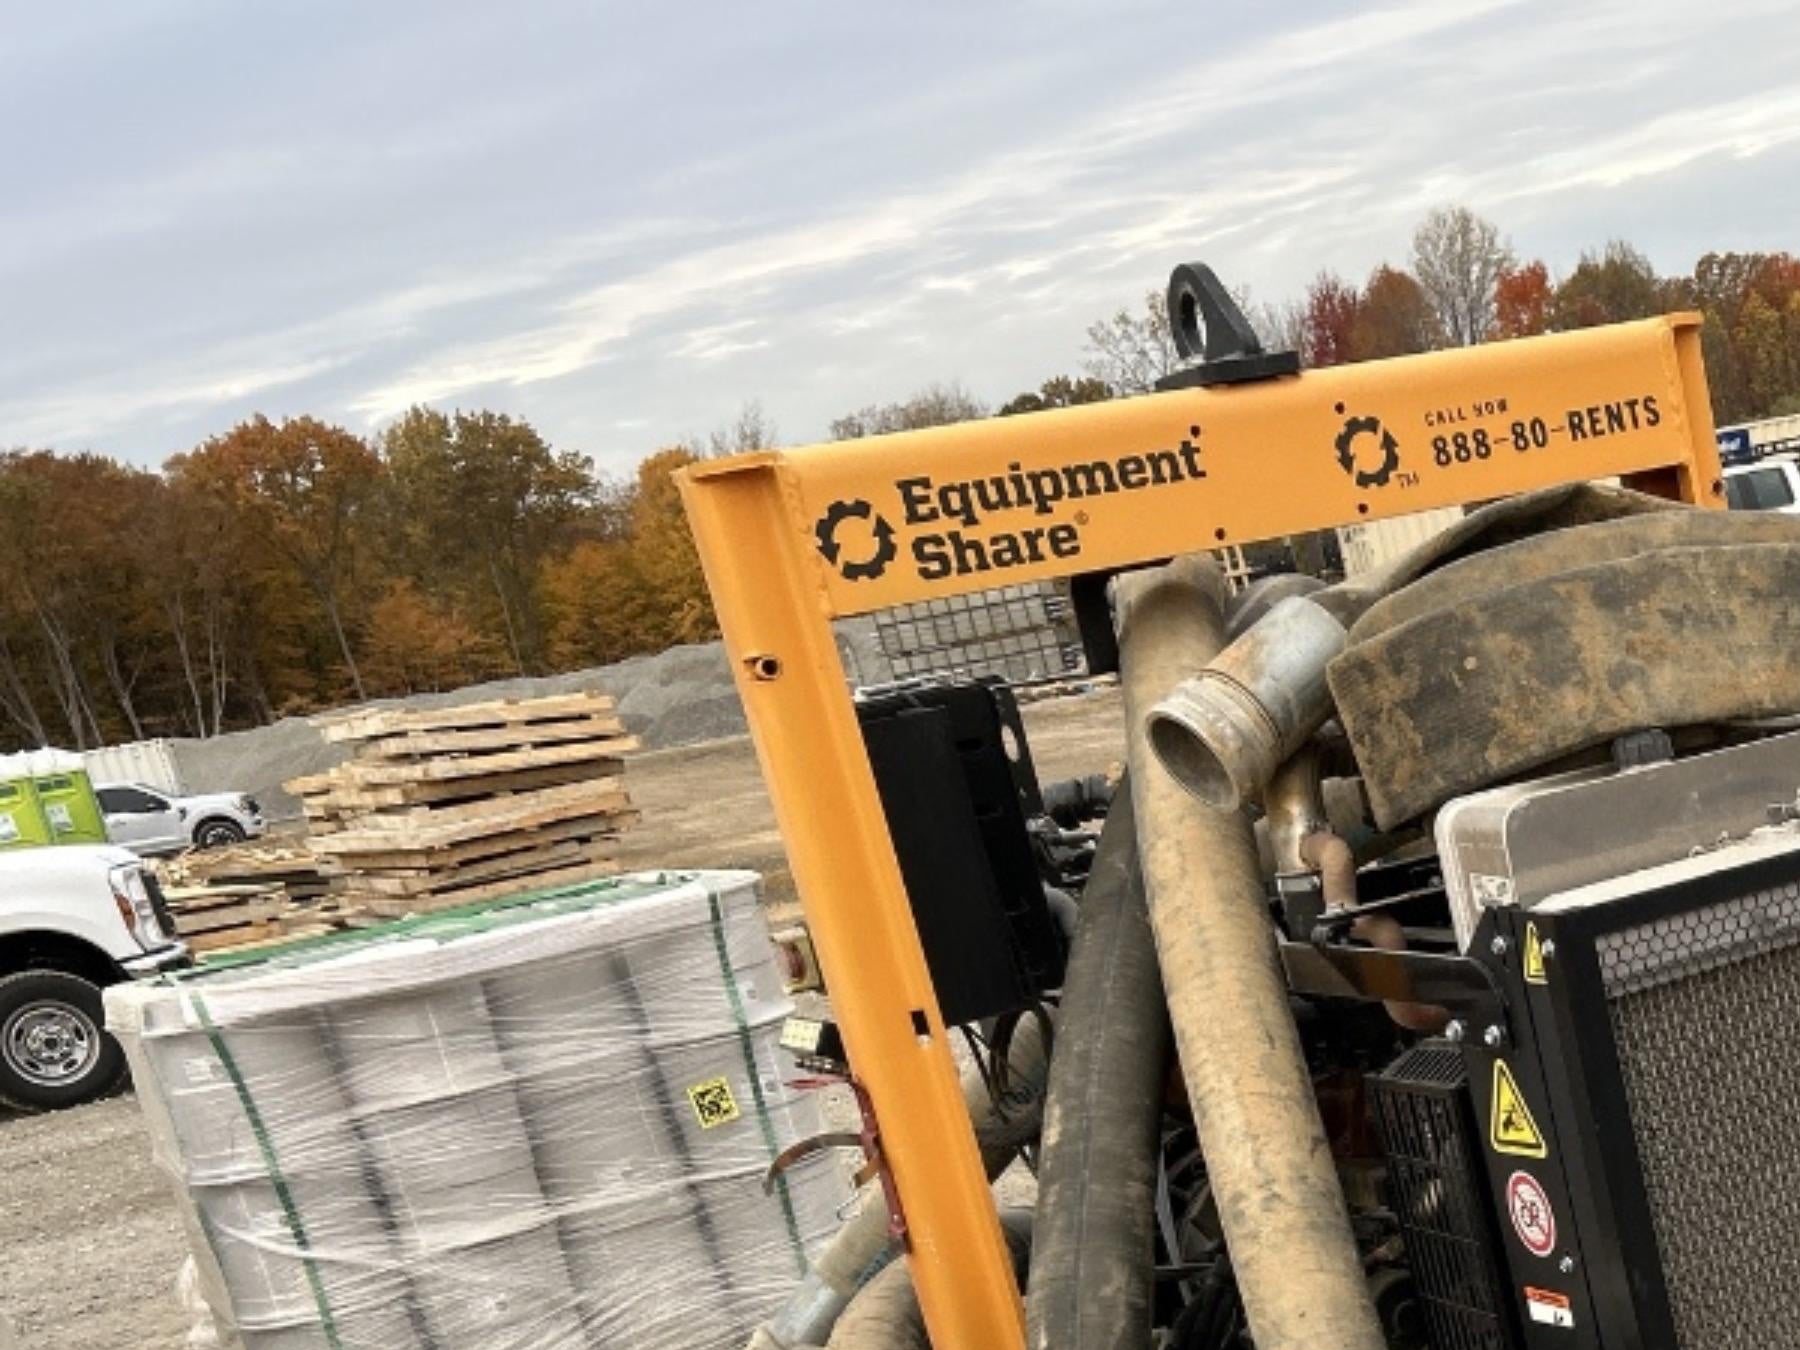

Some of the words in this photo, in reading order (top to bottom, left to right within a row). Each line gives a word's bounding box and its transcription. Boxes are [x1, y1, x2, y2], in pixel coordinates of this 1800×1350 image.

[1424, 406, 1468, 427] CALL
[1432, 396, 1660, 466] 888-80-RENTS
[896, 440, 1206, 525] Equipment
